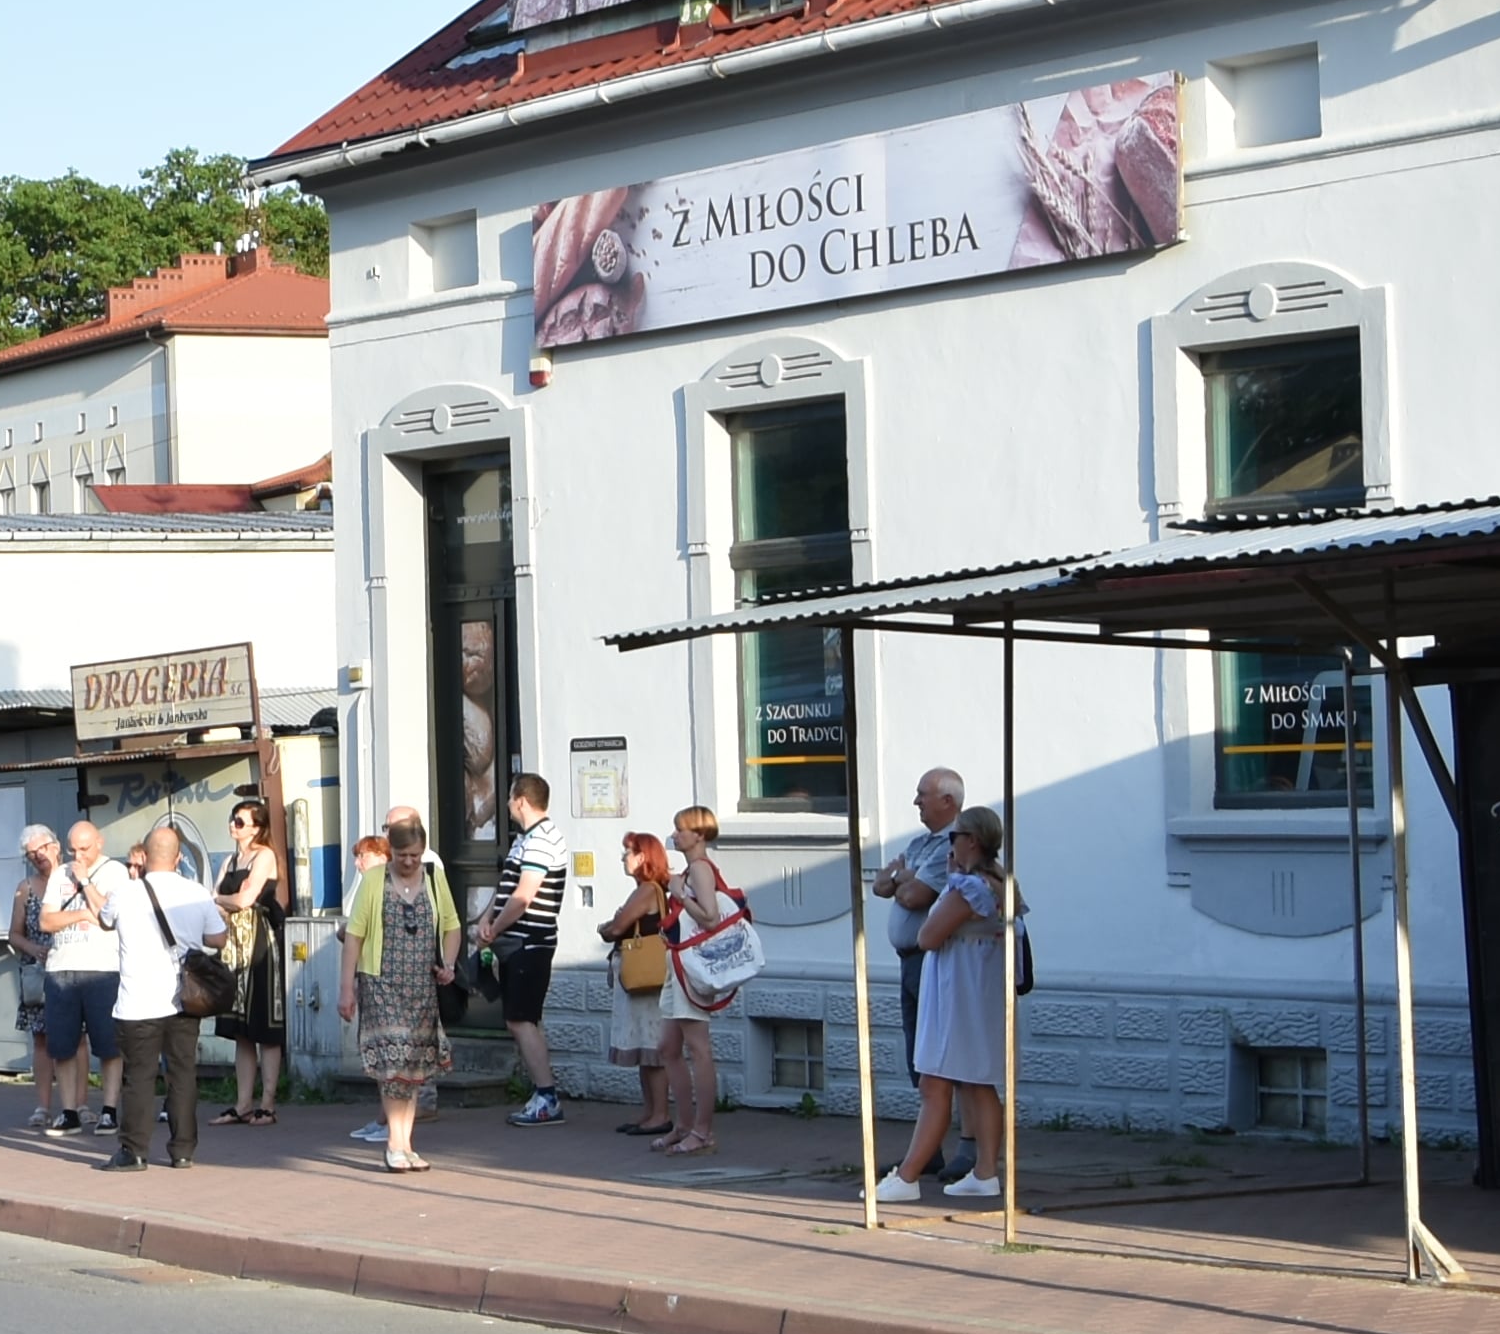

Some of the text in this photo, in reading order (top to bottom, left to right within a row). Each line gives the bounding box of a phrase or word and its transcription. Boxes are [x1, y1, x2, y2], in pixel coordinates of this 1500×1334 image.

[749, 212, 980, 289] DO CHLEBA
[85, 656, 228, 710] DROGERIA
[768, 728, 787, 744] DO
[1271, 712, 1296, 730] DO
